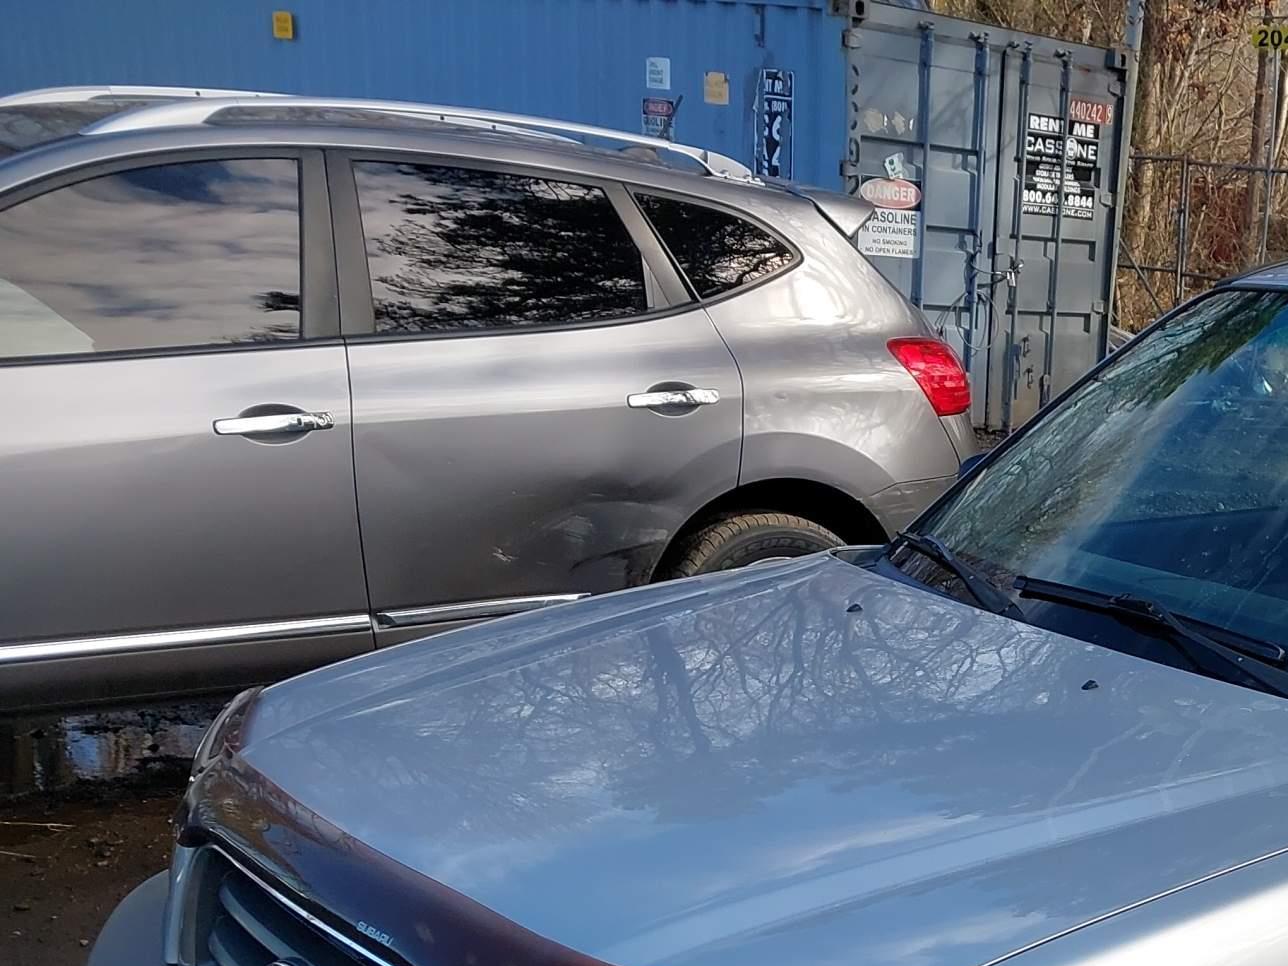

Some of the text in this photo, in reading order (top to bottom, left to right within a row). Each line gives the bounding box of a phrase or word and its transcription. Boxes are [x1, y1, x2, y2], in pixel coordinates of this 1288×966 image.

[1070, 100, 1102, 122] 440242
[1072, 121, 1095, 137] ME
[866, 184, 917, 203] DANGER
[871, 211, 917, 225] ASOLINE
[862, 225, 917, 236] IN CONTAINERS
[357, 920, 394, 947] SUBARU
